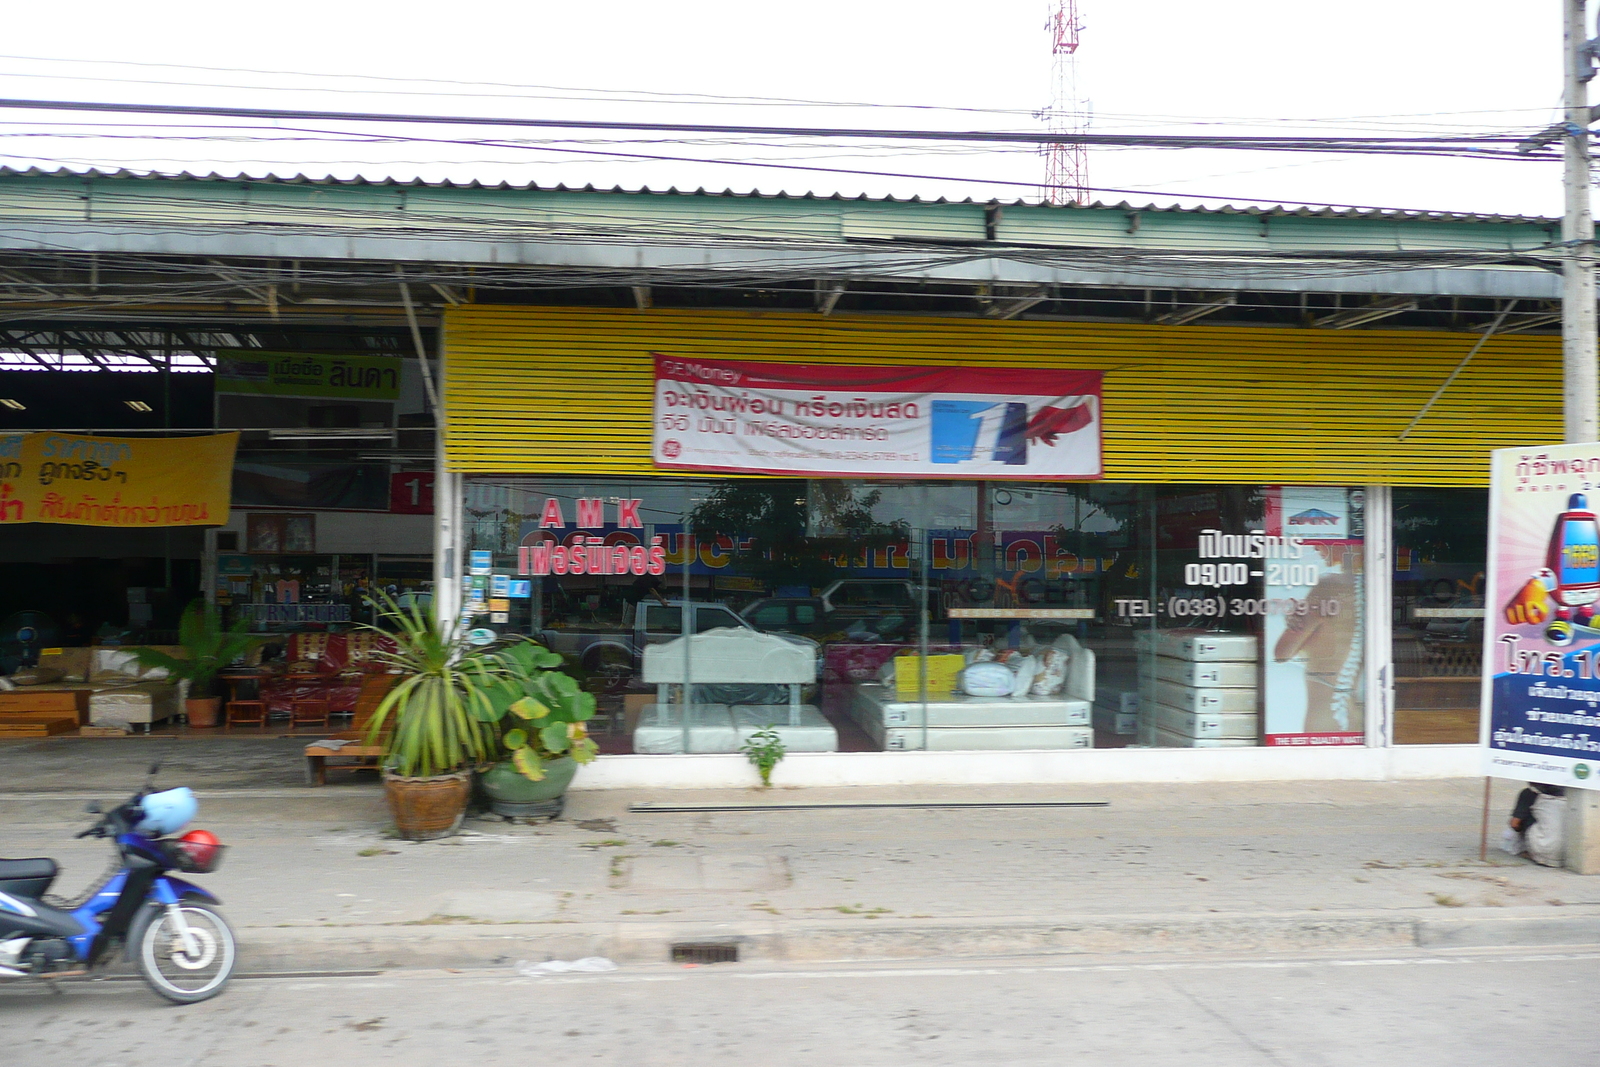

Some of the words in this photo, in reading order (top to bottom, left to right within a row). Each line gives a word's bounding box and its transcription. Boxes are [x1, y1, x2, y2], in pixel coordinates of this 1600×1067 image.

[685, 363, 740, 384] Money
[793, 394, 919, 418] หรือเงินสด
[518, 534, 667, 575] เฟอร์นิเจอร์
[1198, 529, 1303, 559] เปิดบริการ
[1167, 596, 1226, 618] (038)
